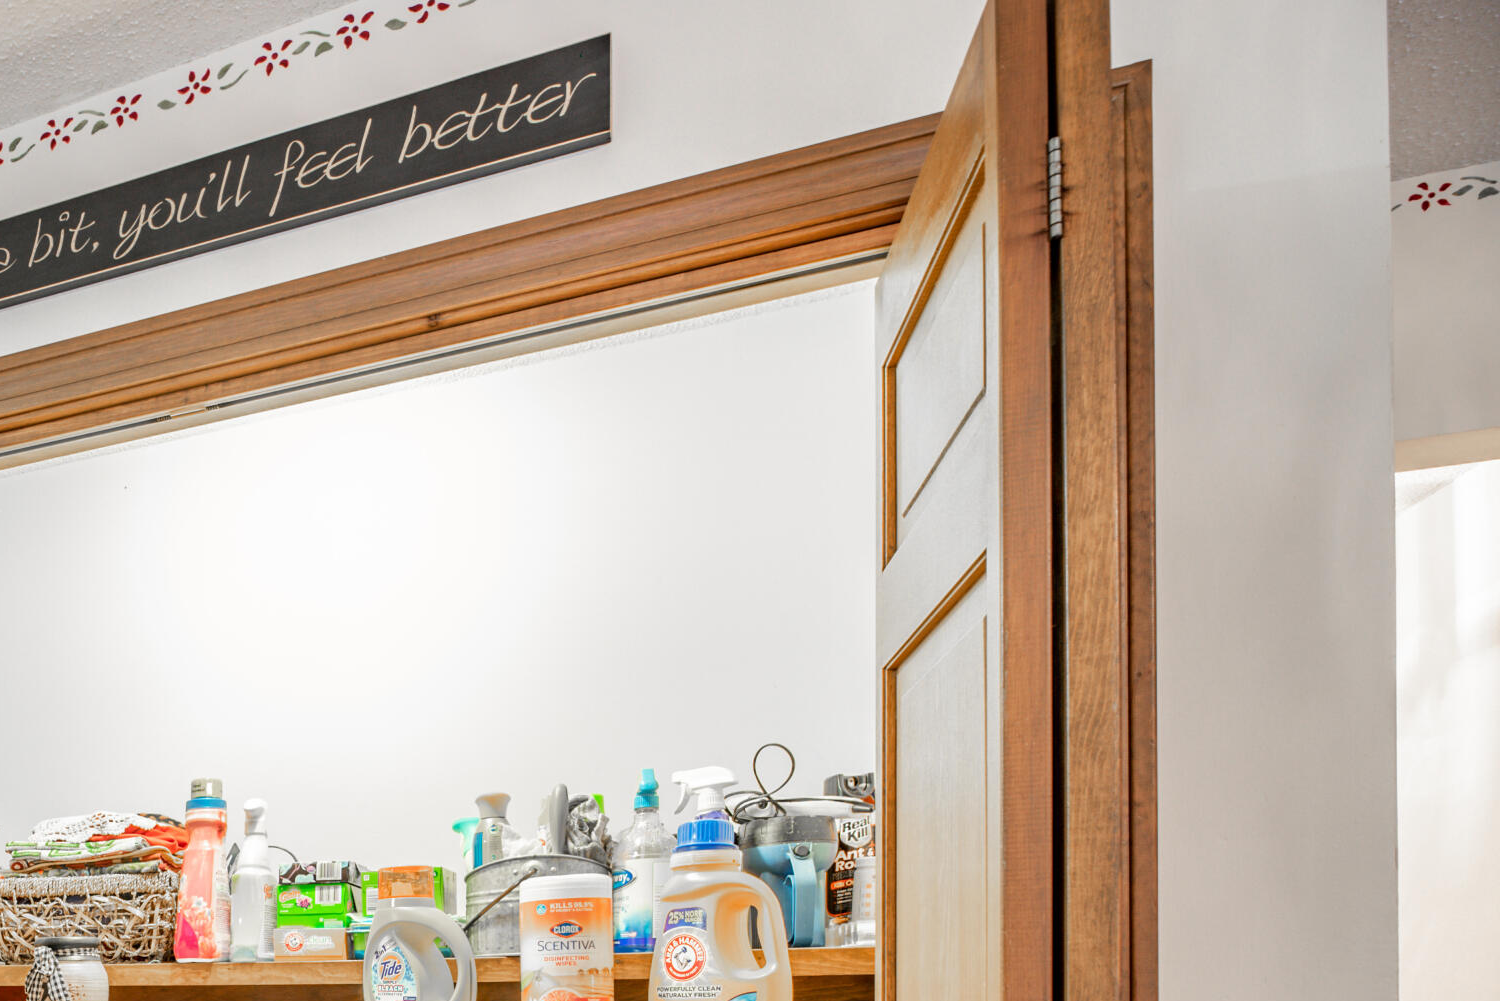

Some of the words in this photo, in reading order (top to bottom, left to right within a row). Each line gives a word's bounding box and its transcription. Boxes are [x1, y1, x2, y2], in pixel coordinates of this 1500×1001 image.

[27, 213, 101, 268] bit,
[115, 154, 256, 260] you'll
[269, 117, 374, 216] feel
[397, 71, 598, 166] better
[842, 815, 870, 833] Real
[847, 826, 868, 842] Kill
[835, 847, 865, 861] Ant
[834, 860, 857, 873] Ro
[668, 911, 684, 925] 25%
[553, 925, 579, 933] CLOROX
[537, 939, 596, 952] SCENTIVA
[678, 936, 704, 962] HAMMER
[380, 960, 402, 980] Tide
